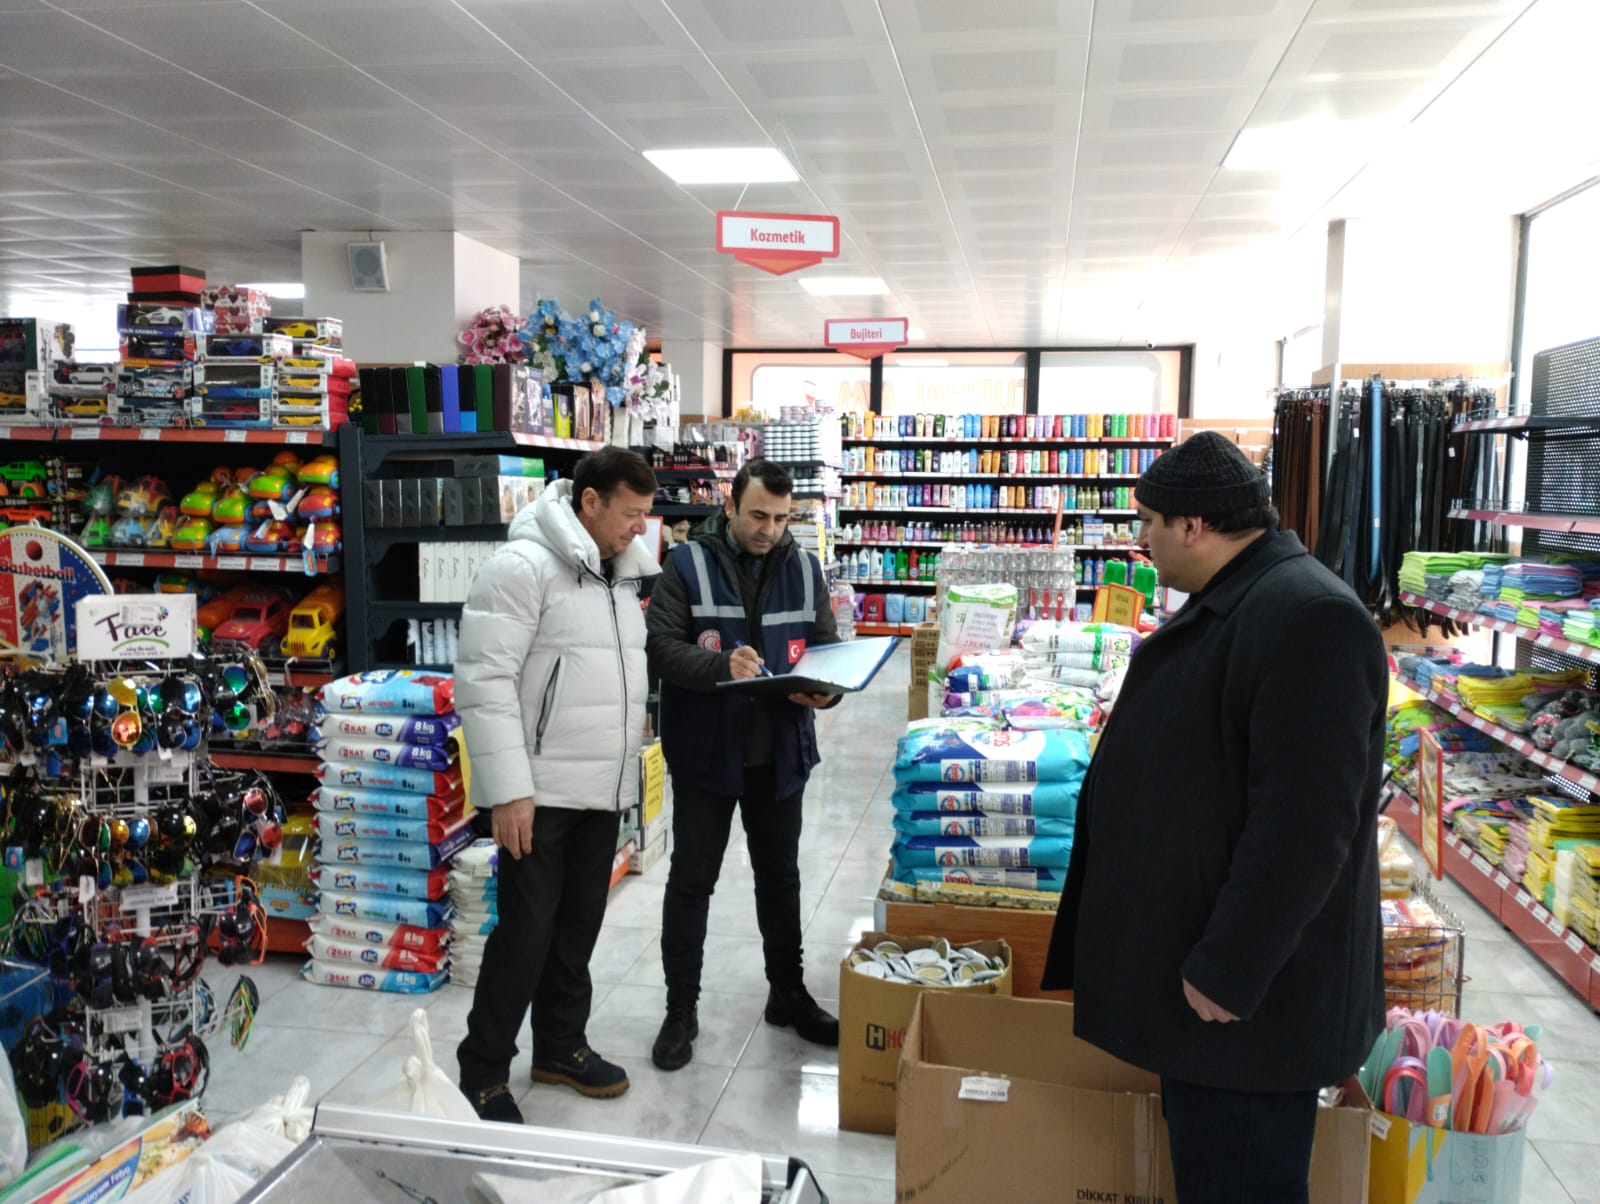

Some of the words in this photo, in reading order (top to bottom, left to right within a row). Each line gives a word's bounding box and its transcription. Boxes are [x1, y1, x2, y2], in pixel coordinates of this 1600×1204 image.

[750, 228, 806, 244] Kozmetik
[850, 328, 883, 341] Bujiteri
[94, 612, 167, 642] Face
[376, 724, 392, 735] ABC
[375, 749, 390, 760] ABC
[360, 976, 375, 986] ABC
[1076, 1187, 1120, 1203] DİKKAT
